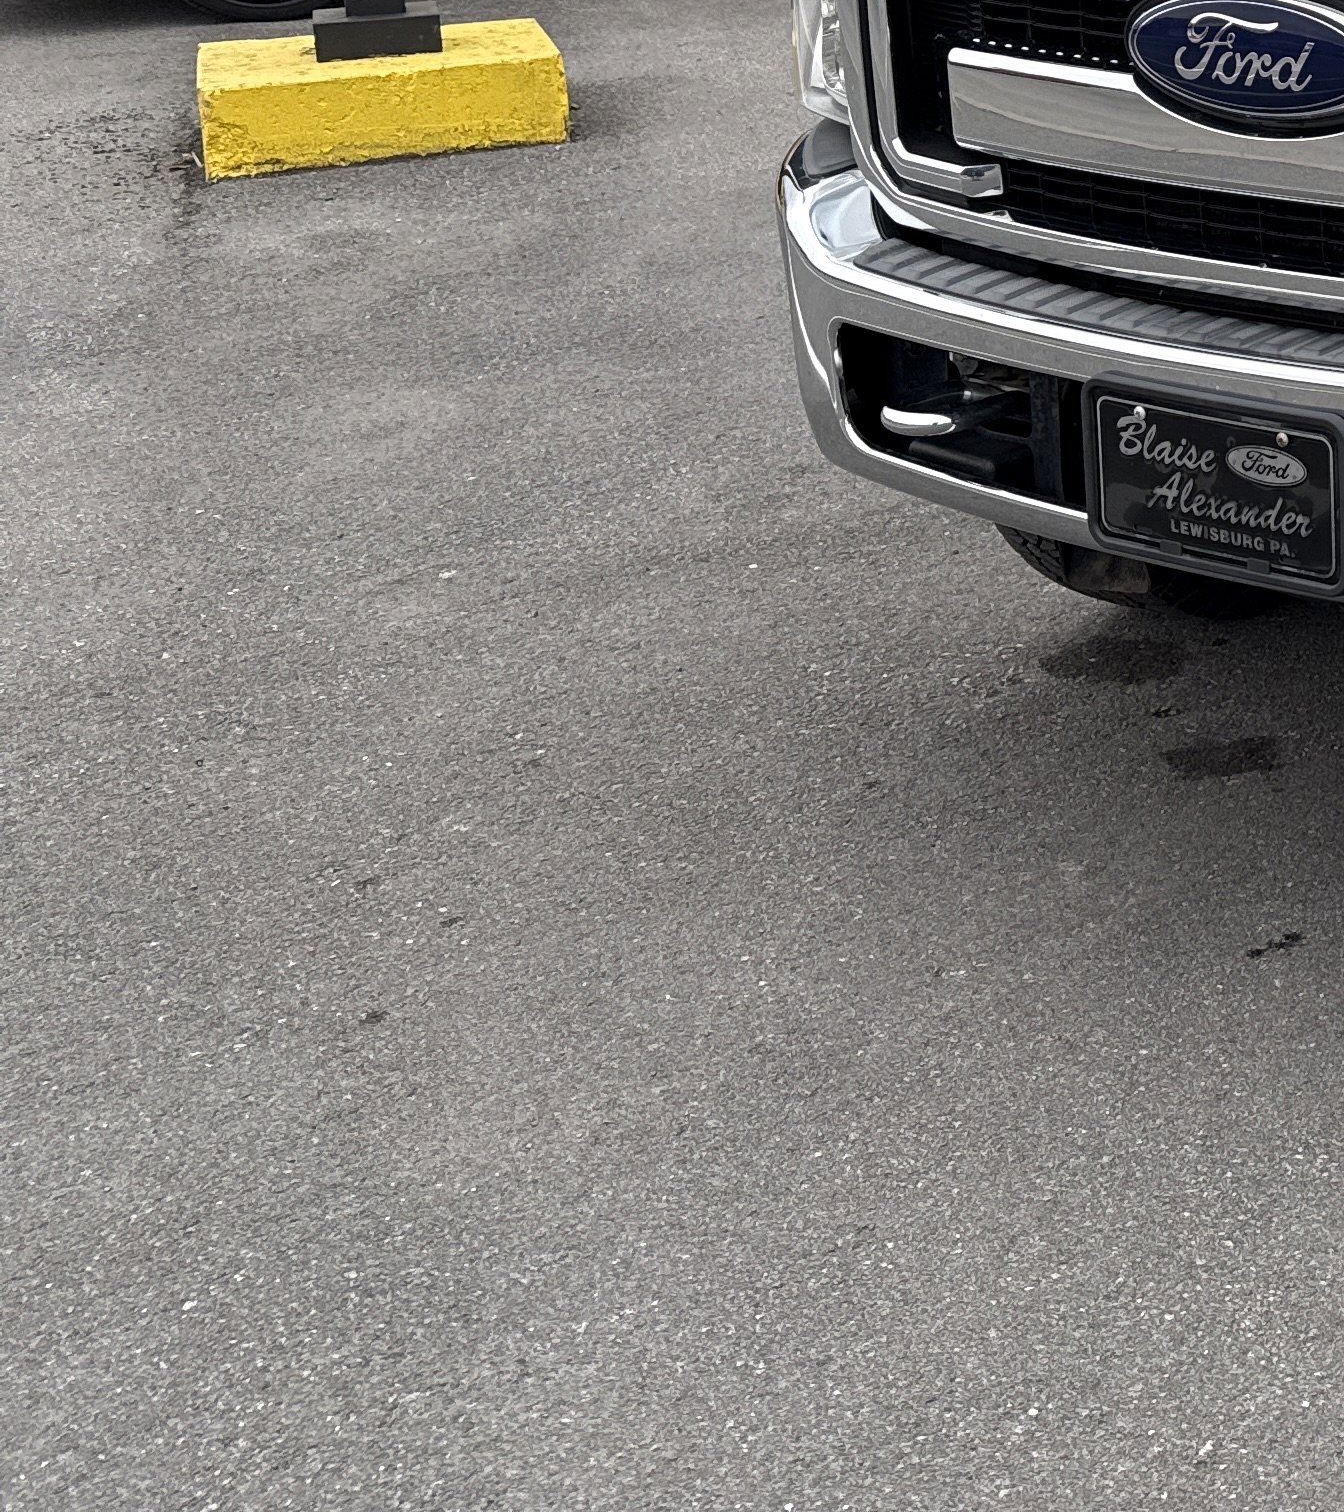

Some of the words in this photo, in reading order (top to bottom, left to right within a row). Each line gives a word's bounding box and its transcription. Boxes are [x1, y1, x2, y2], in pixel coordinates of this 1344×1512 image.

[1174, 11, 1316, 92] Ford
[1116, 415, 1217, 473] Blaise
[1241, 450, 1290, 480] Ford
[1147, 472, 1313, 538] Alexander
[1170, 518, 1265, 552] LEWISBURG
